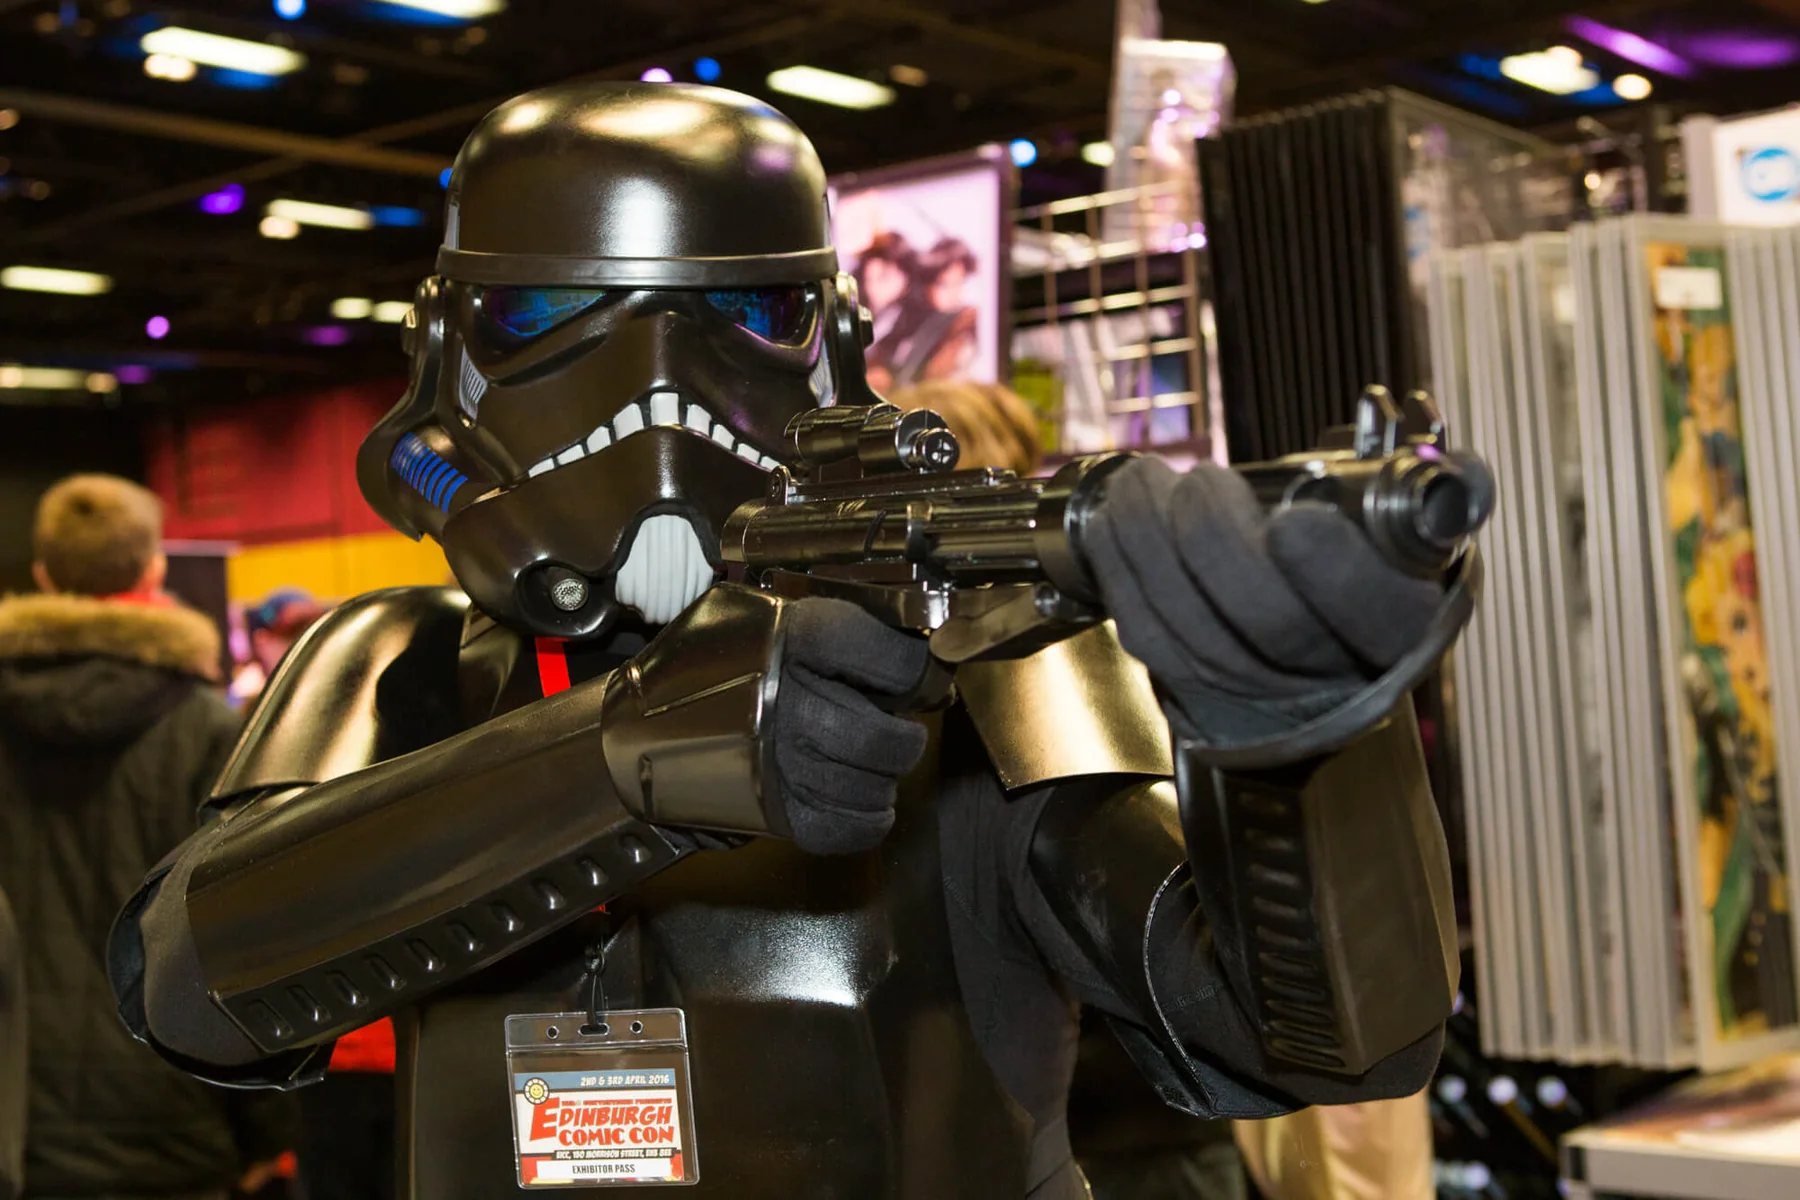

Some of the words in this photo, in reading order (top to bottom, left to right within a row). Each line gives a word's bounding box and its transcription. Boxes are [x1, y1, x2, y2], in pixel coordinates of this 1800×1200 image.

[598, 1076, 605, 1086] &
[624, 1075, 647, 1085] APRIL
[648, 1075, 669, 1084] 2016
[530, 1097, 673, 1141] EDINBURGH
[559, 1129, 625, 1146] COMIC
[629, 1126, 674, 1144] CON
[572, 1165, 613, 1175] EXHIBITOR
[615, 1164, 635, 1173] PASS
